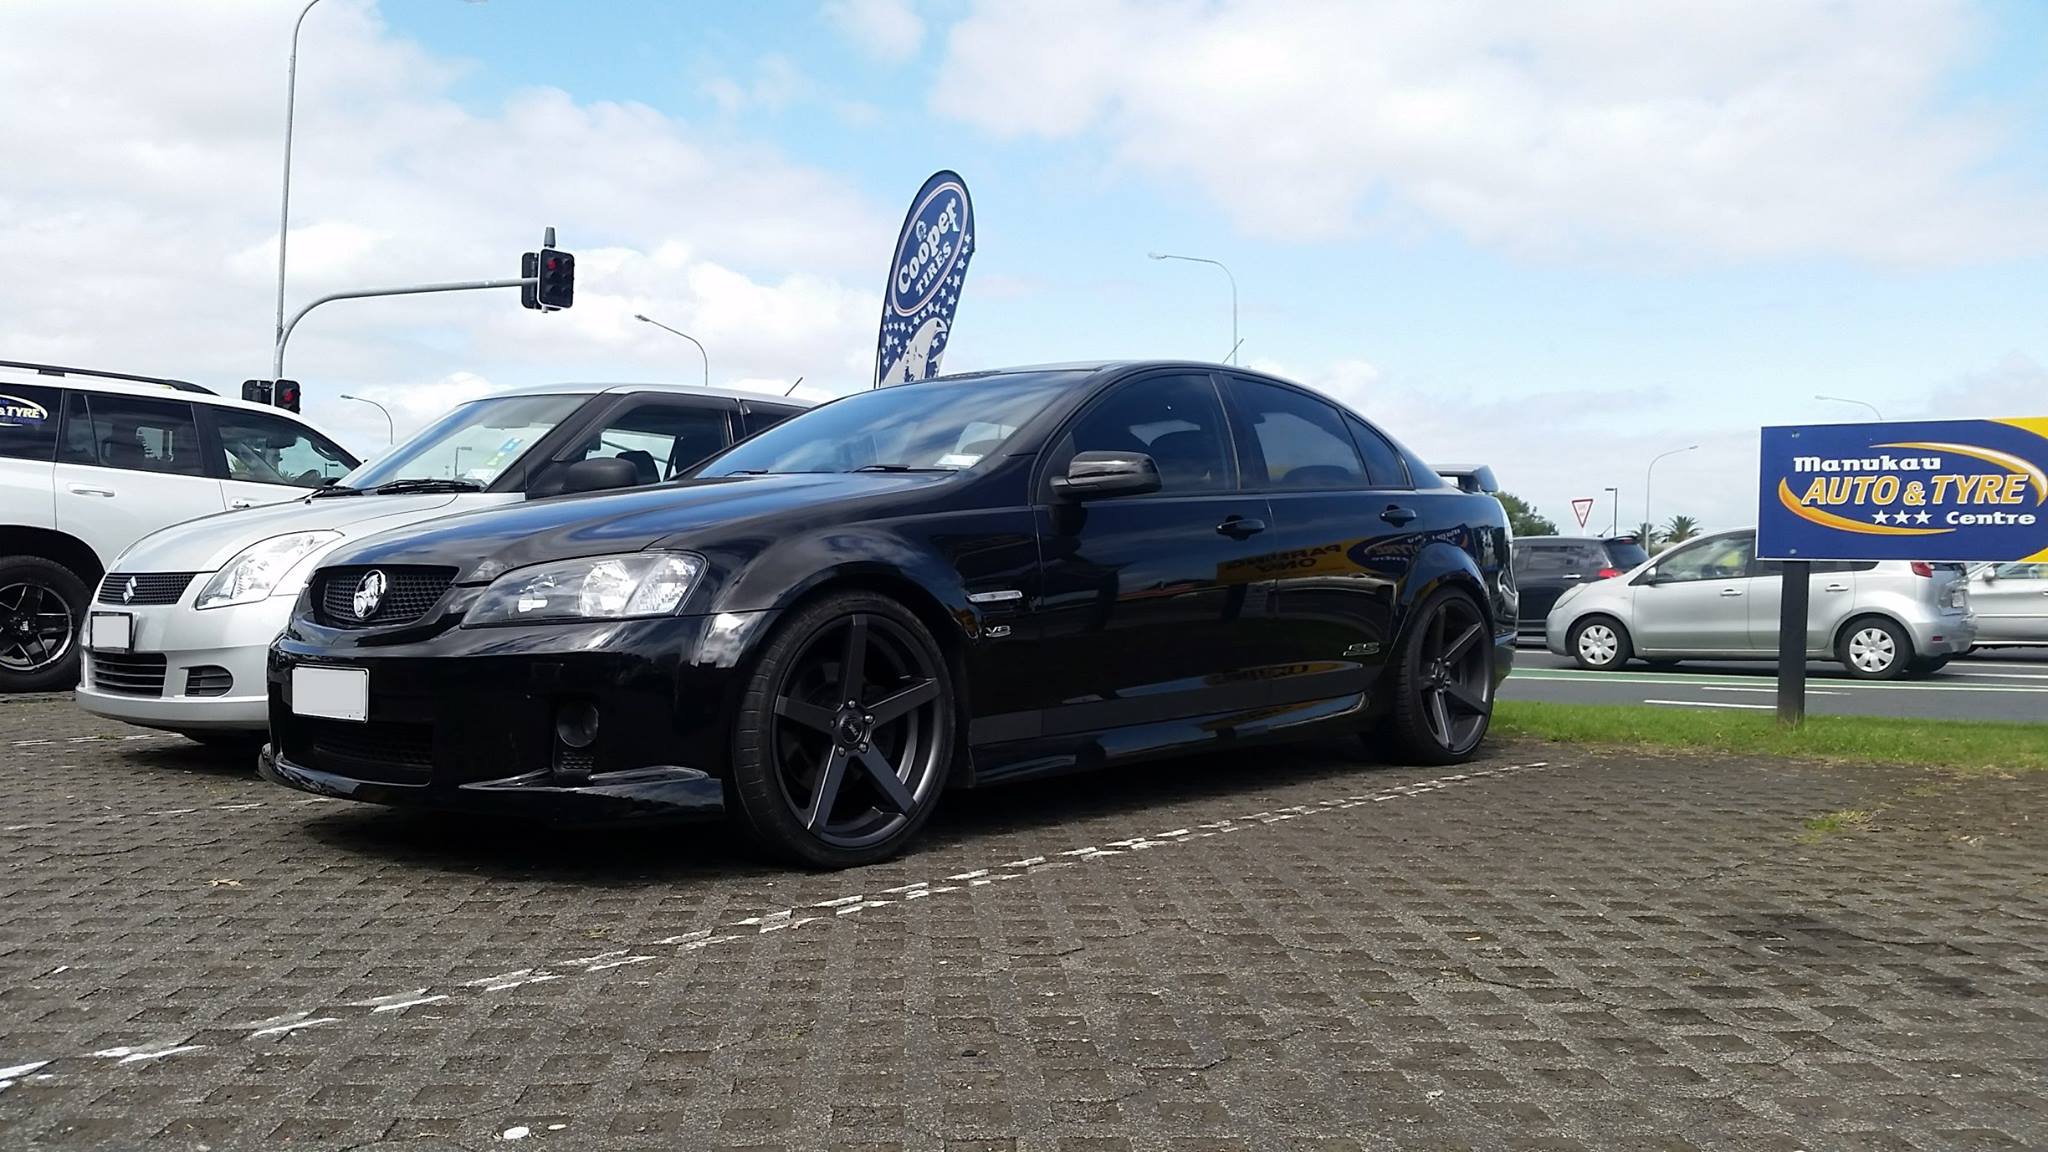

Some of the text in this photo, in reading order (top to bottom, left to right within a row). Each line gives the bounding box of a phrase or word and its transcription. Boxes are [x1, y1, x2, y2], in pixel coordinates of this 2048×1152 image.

[898, 198, 960, 293] Cooper
[916, 242, 951, 296] TIRES
[6, 406, 41, 418] TYRE
[1793, 456, 1941, 472] Manukau
[1801, 474, 2029, 506] AUTO & TYRE
[1946, 511, 2036, 525] Centre
